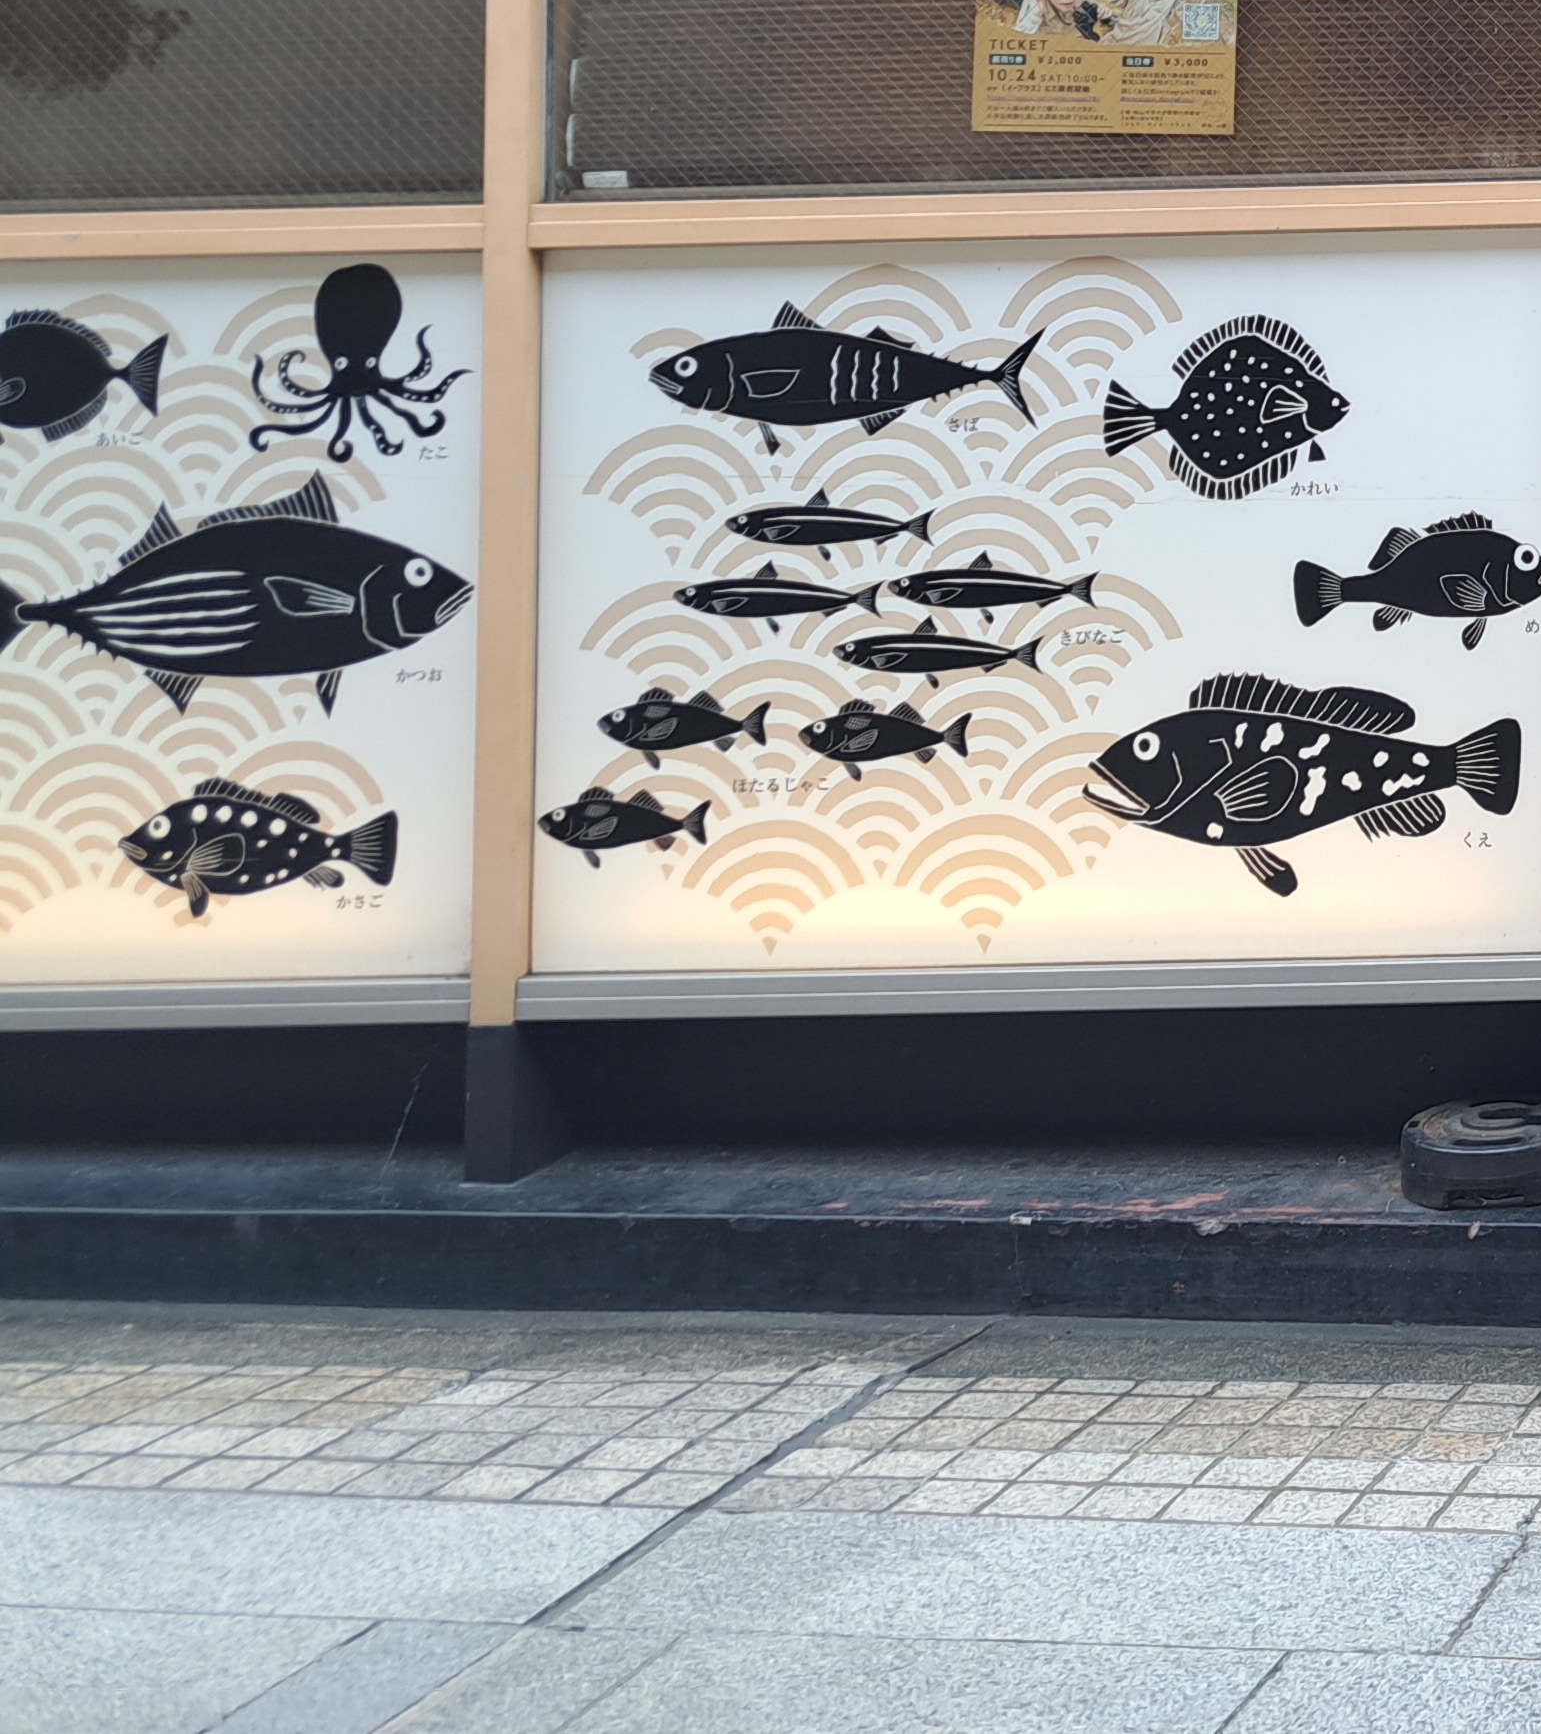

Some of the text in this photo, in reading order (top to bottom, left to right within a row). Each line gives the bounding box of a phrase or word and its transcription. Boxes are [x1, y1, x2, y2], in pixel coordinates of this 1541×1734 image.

[989, 39, 1048, 51] TICKET
[947, 417, 980, 434] さば
[95, 429, 143, 447] あいご
[417, 444, 450, 461] たこ
[1290, 479, 1340, 497] かれい
[1059, 628, 1126, 646] きびなご
[394, 667, 443, 684] かつお
[731, 776, 830, 795] ほたるじゃこ
[1461, 831, 1493, 850] くえ
[335, 892, 385, 911] かさご
